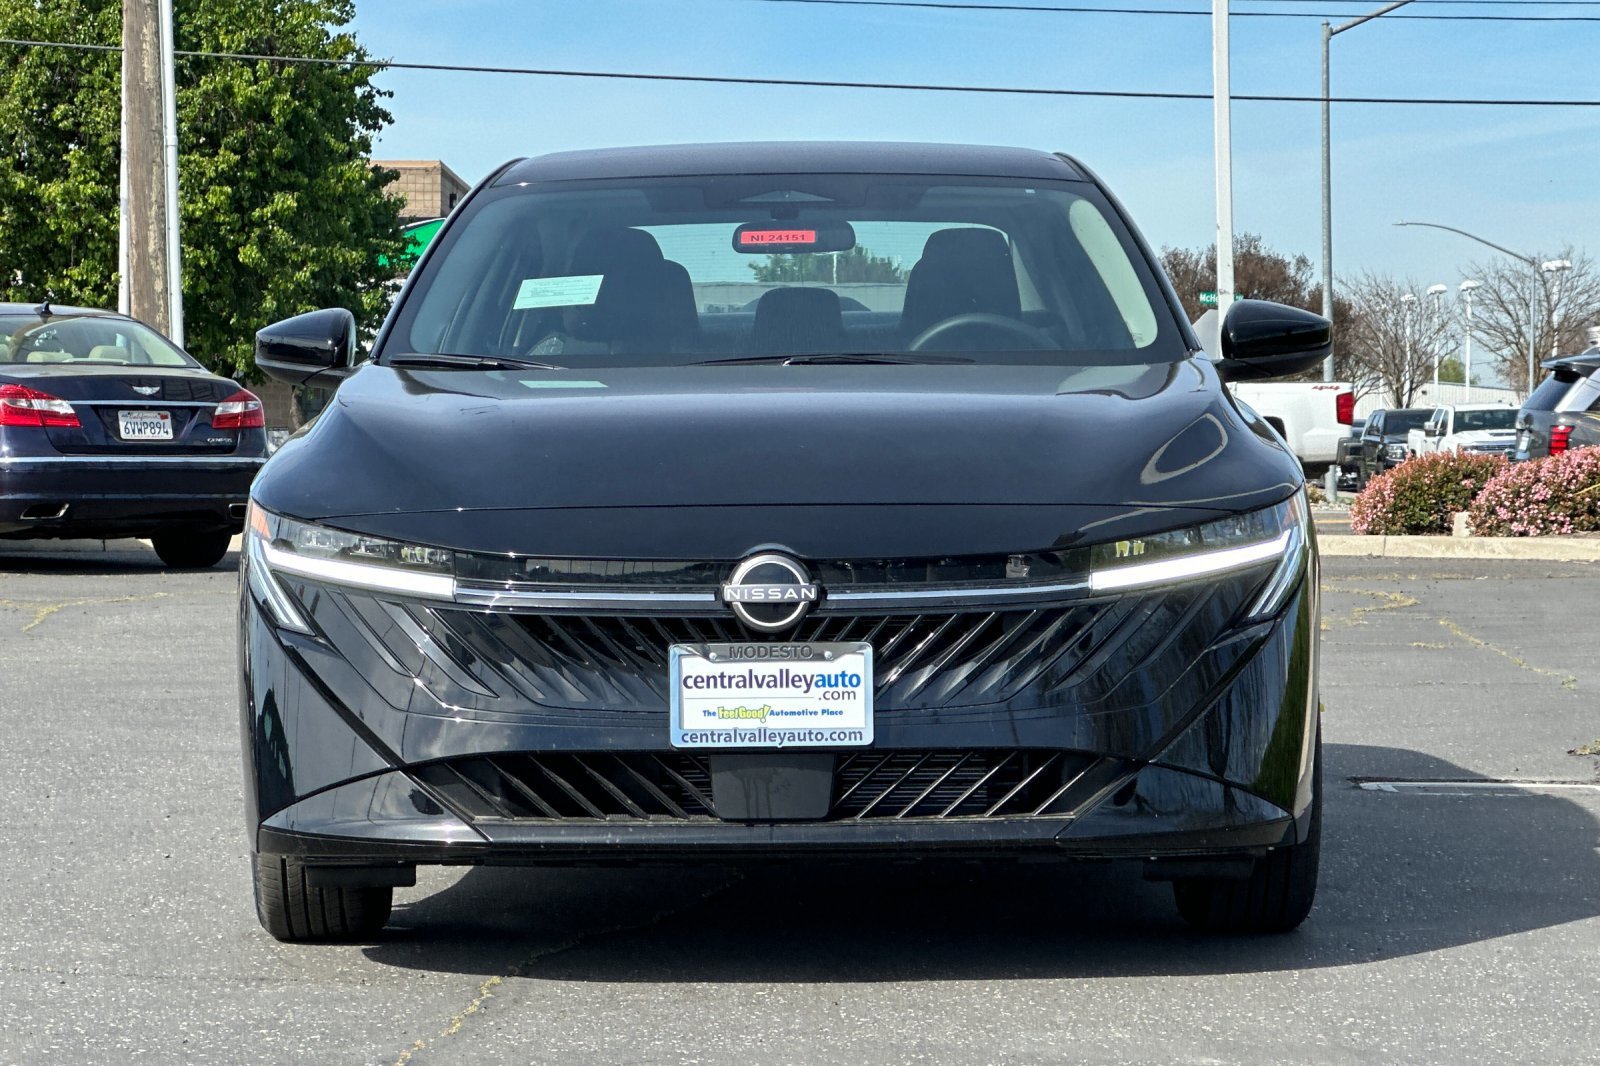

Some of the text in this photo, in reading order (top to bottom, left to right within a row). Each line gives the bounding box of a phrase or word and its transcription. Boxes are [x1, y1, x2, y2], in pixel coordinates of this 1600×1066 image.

[124, 421, 169, 436] 6VWP894
[726, 587, 816, 600] NISSAN
[728, 645, 814, 660] MODESTO
[818, 690, 857, 701] .com
[702, 709, 717, 717] The
[769, 708, 819, 717] Automotive
[821, 708, 844, 716] Place
[681, 728, 864, 746] centralvalleyauto.com
